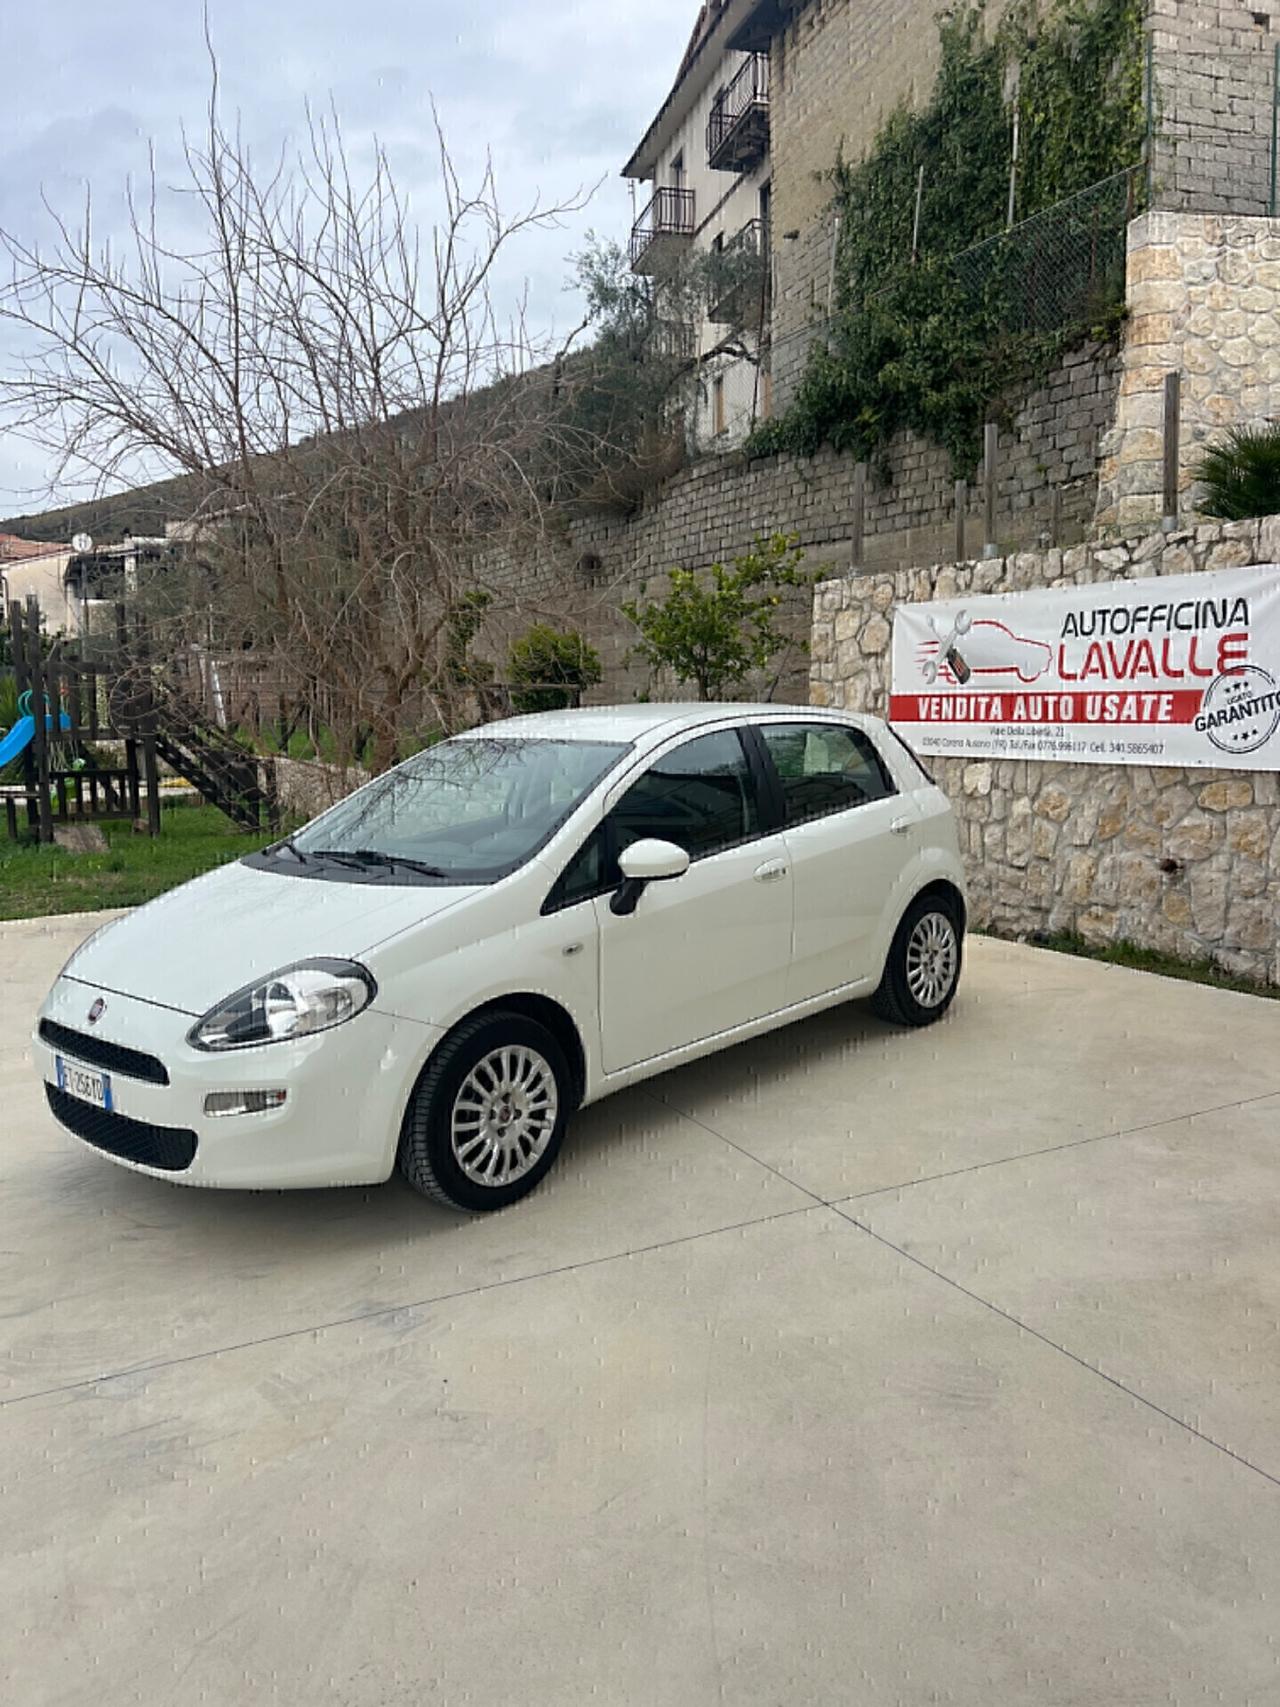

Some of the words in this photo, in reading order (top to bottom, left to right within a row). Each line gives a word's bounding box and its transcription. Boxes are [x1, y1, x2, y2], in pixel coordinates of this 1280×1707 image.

[1061, 598, 1249, 638] AUTOFFICINA
[1057, 633, 1249, 680] LAVALLE
[917, 695, 1002, 720] VENDITA
[1012, 694, 1075, 720] AUTO
[1086, 694, 1173, 721] USATE
